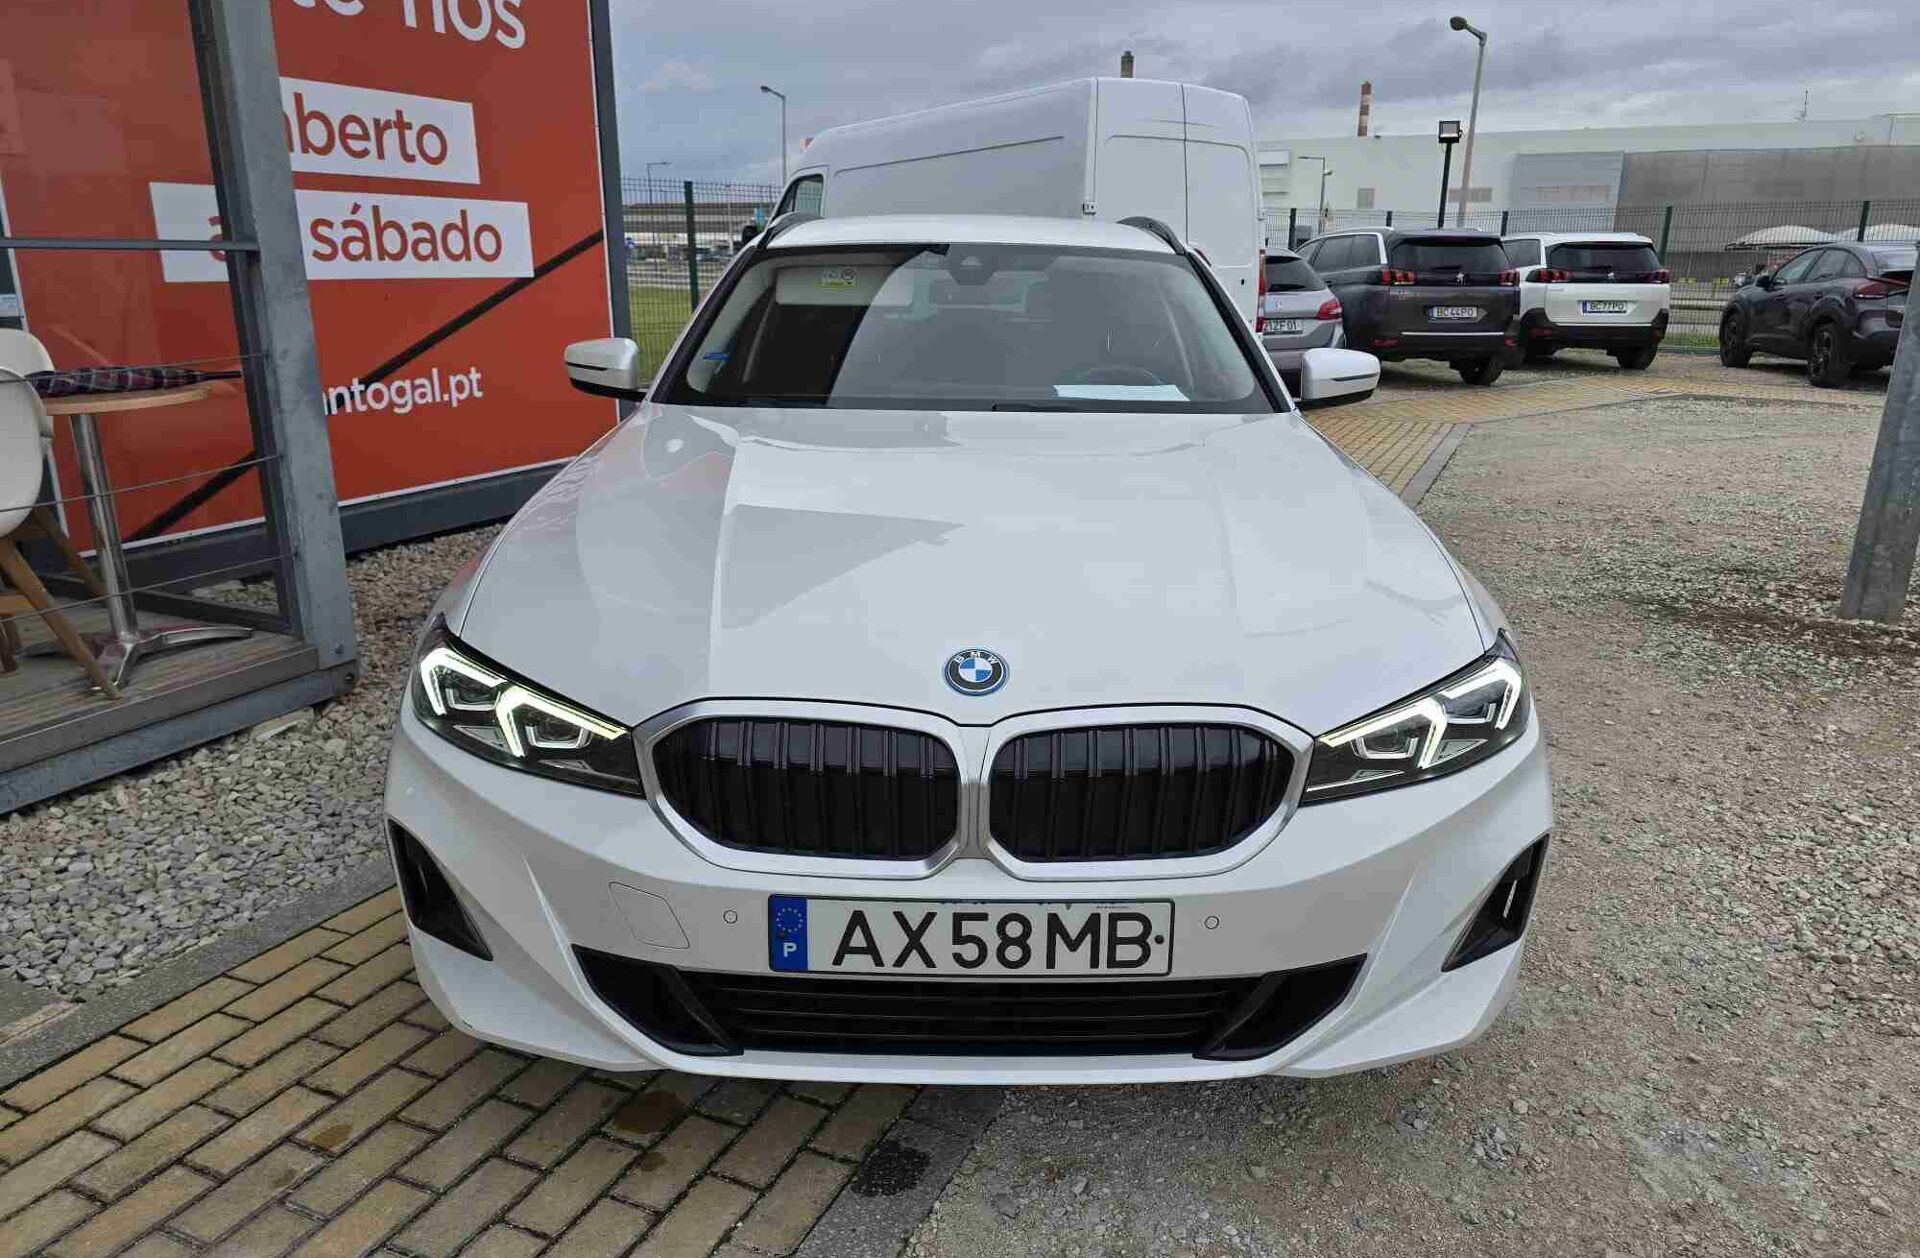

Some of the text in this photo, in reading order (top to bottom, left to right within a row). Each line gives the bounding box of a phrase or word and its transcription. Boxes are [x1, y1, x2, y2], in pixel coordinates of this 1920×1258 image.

[284, 92, 448, 165] berto
[310, 202, 502, 262] sábado
[323, 366, 484, 416] ntogal.pt
[783, 942, 798, 957] P
